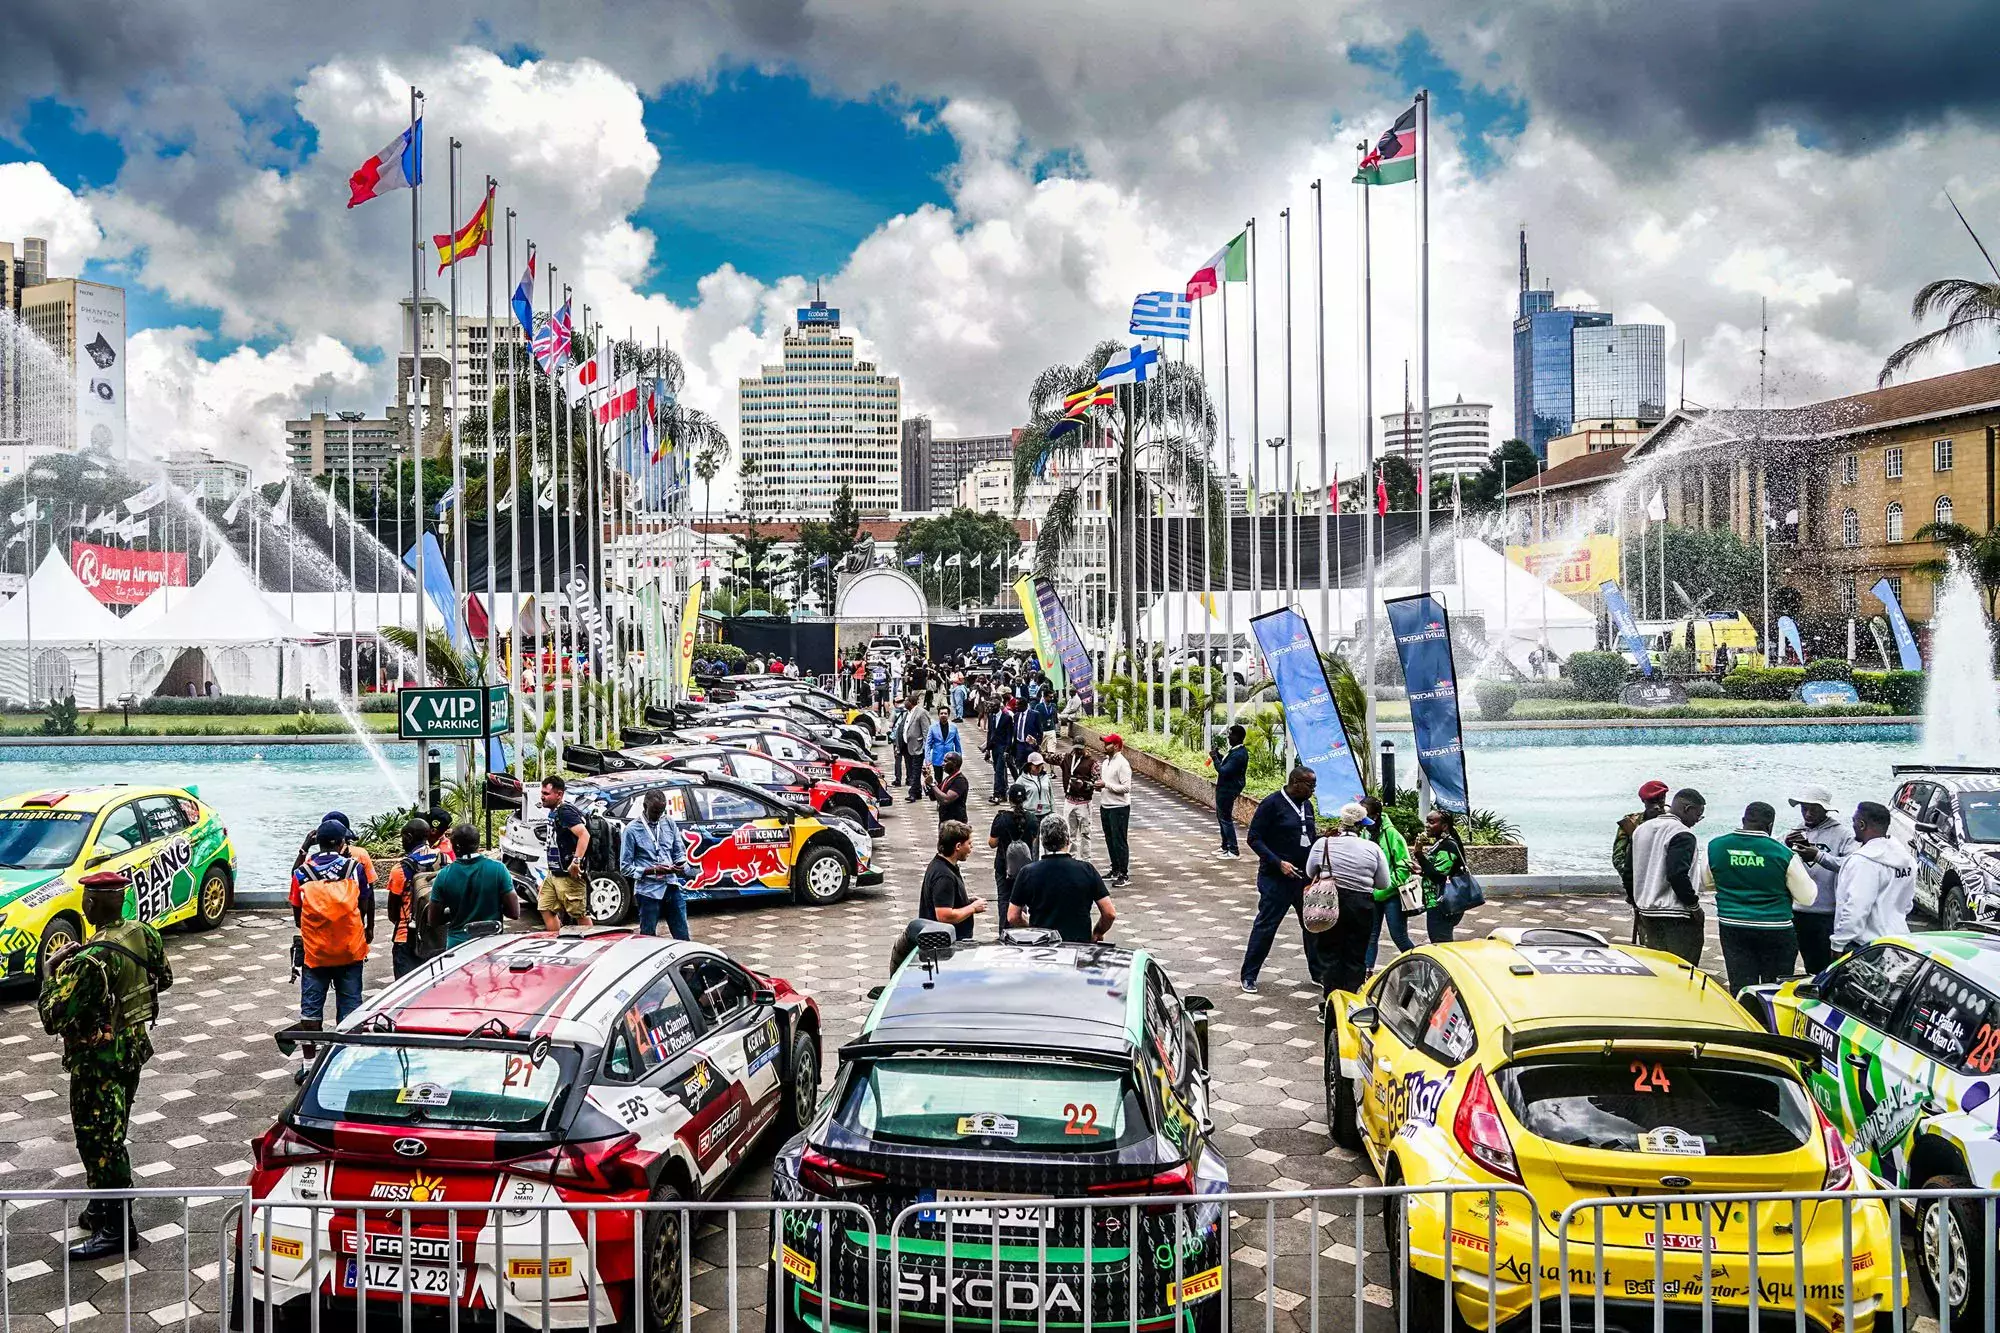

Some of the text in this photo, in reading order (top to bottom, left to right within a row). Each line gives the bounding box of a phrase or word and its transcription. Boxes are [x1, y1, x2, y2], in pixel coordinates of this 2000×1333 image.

[80, 306, 120, 319] PHANTOM
[807, 310, 829, 318] Ecobank
[101, 563, 169, 587] Kenya Airway
[429, 697, 476, 718] VIP
[490, 701, 505, 721] EXIT
[427, 719, 480, 730] PARKING
[808, 766, 828, 775] KENYA
[672, 795, 685, 812] 16
[781, 792, 805, 802] KENYA
[735, 829, 784, 845] HY KENYA
[133, 835, 191, 900] BANG
[1730, 855, 1765, 867] ROAR
[139, 882, 172, 923] BET
[513, 940, 584, 955] 21
[1000, 947, 1059, 962] 22
[1537, 948, 1618, 965] 24
[497, 955, 568, 965] KENYA
[1551, 964, 1639, 975] KENYA
[657, 1013, 690, 1040] N. Ciamin
[1809, 1022, 1834, 1052] KENYA
[1953, 1022, 1964, 1038] A+
[662, 1040, 672, 1056] Y.
[669, 1030, 692, 1053] Roche
[746, 1027, 766, 1054] KENYA
[1967, 1023, 2000, 1073] 28
[502, 1057, 534, 1088] 21
[1630, 1060, 1671, 1093] 24
[1387, 1069, 1457, 1140] Betika!
[1812, 1079, 1832, 1112] KCB
[616, 1095, 649, 1125] EPS
[1063, 1103, 1100, 1136] 22
[711, 1105, 741, 1145] FACOM
[923, 1210, 931, 1218] D
[262, 1234, 300, 1257] RELLI
[375, 1238, 451, 1258] FACOM
[783, 1247, 812, 1277] RELLI
[1496, 1254, 1612, 1286] Aquamit
[1842, 1251, 1875, 1272] RELLI
[348, 1277, 355, 1285] D
[363, 1263, 400, 1288] ALZ
[409, 1267, 419, 1290] R
[1624, 1279, 1681, 1295] Betia!
[1681, 1280, 1741, 1298] Avator
